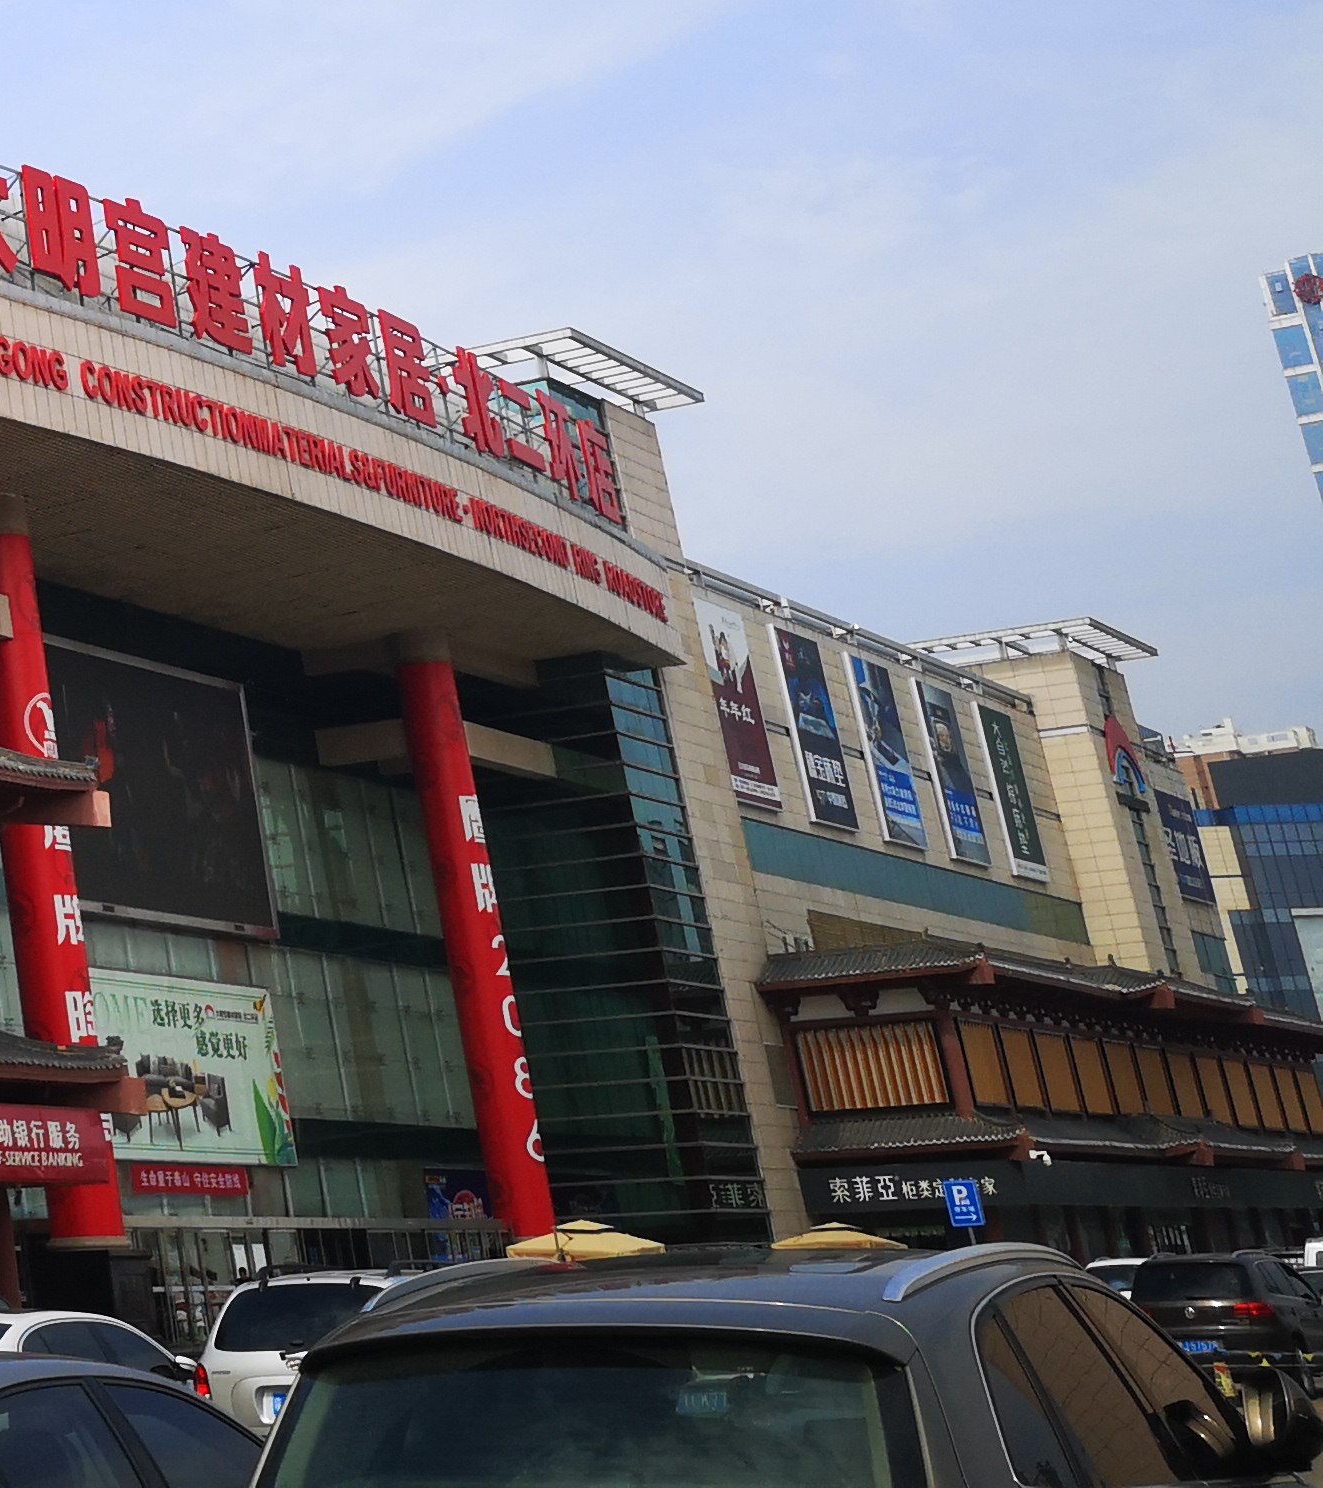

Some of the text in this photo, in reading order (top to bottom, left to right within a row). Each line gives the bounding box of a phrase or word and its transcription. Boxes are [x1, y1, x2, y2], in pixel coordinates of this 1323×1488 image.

[718, 697, 756, 725] 年年红
[150, 999, 206, 1030] 选择更多
[196, 1030, 248, 1060] 感觉更好
[41, 1151, 84, 1167] BANKING
[140, 1170, 191, 1187] 生命重于泰山
[951, 1185, 968, 1206] P
